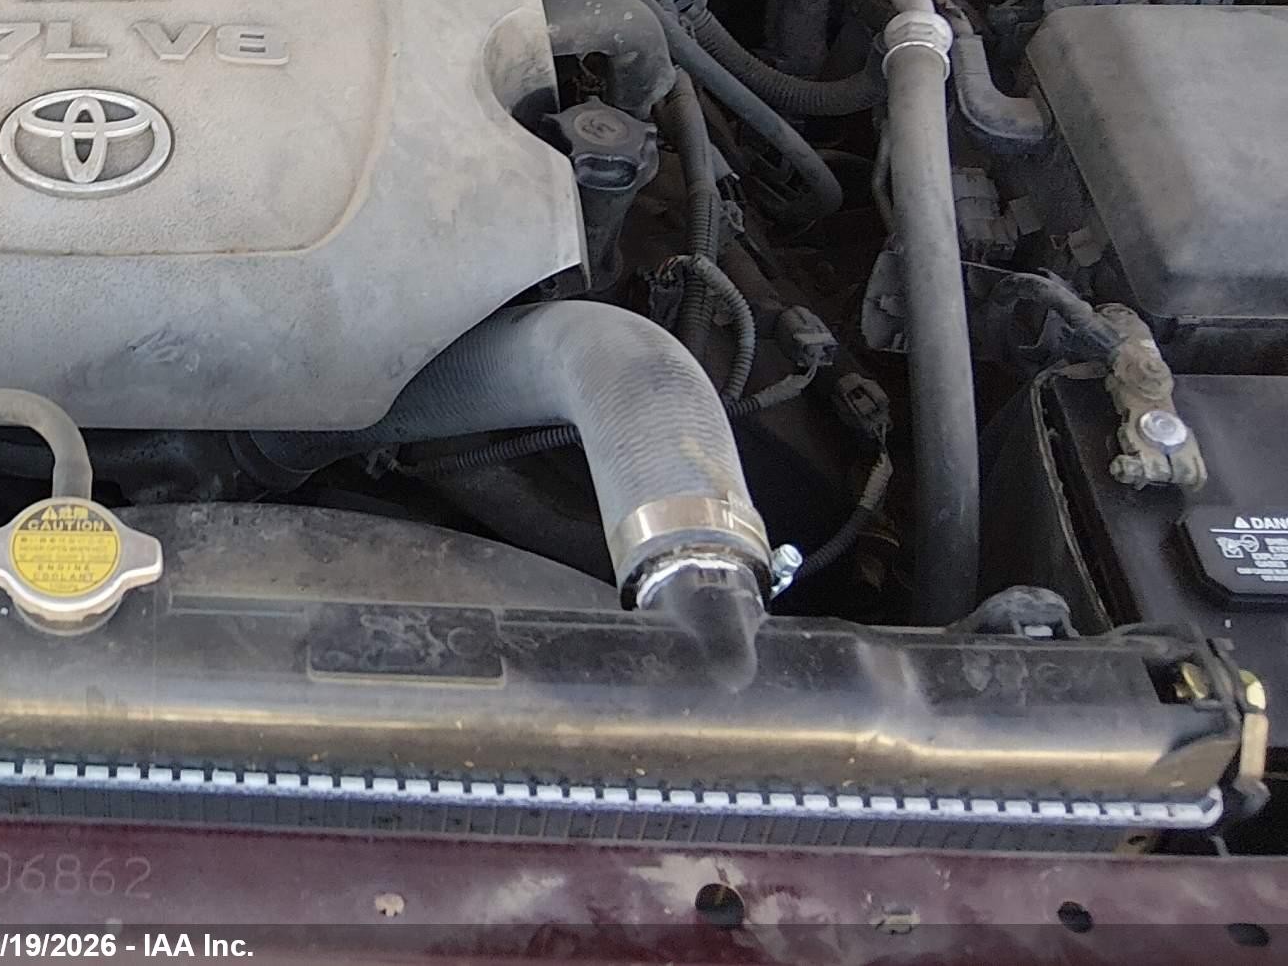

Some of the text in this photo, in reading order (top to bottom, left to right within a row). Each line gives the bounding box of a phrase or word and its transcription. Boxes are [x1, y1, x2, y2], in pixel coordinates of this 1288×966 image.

[132, 23, 290, 66] V8
[27, 519, 105, 532] CAUTION
[1250, 516, 1288, 530] DAN
